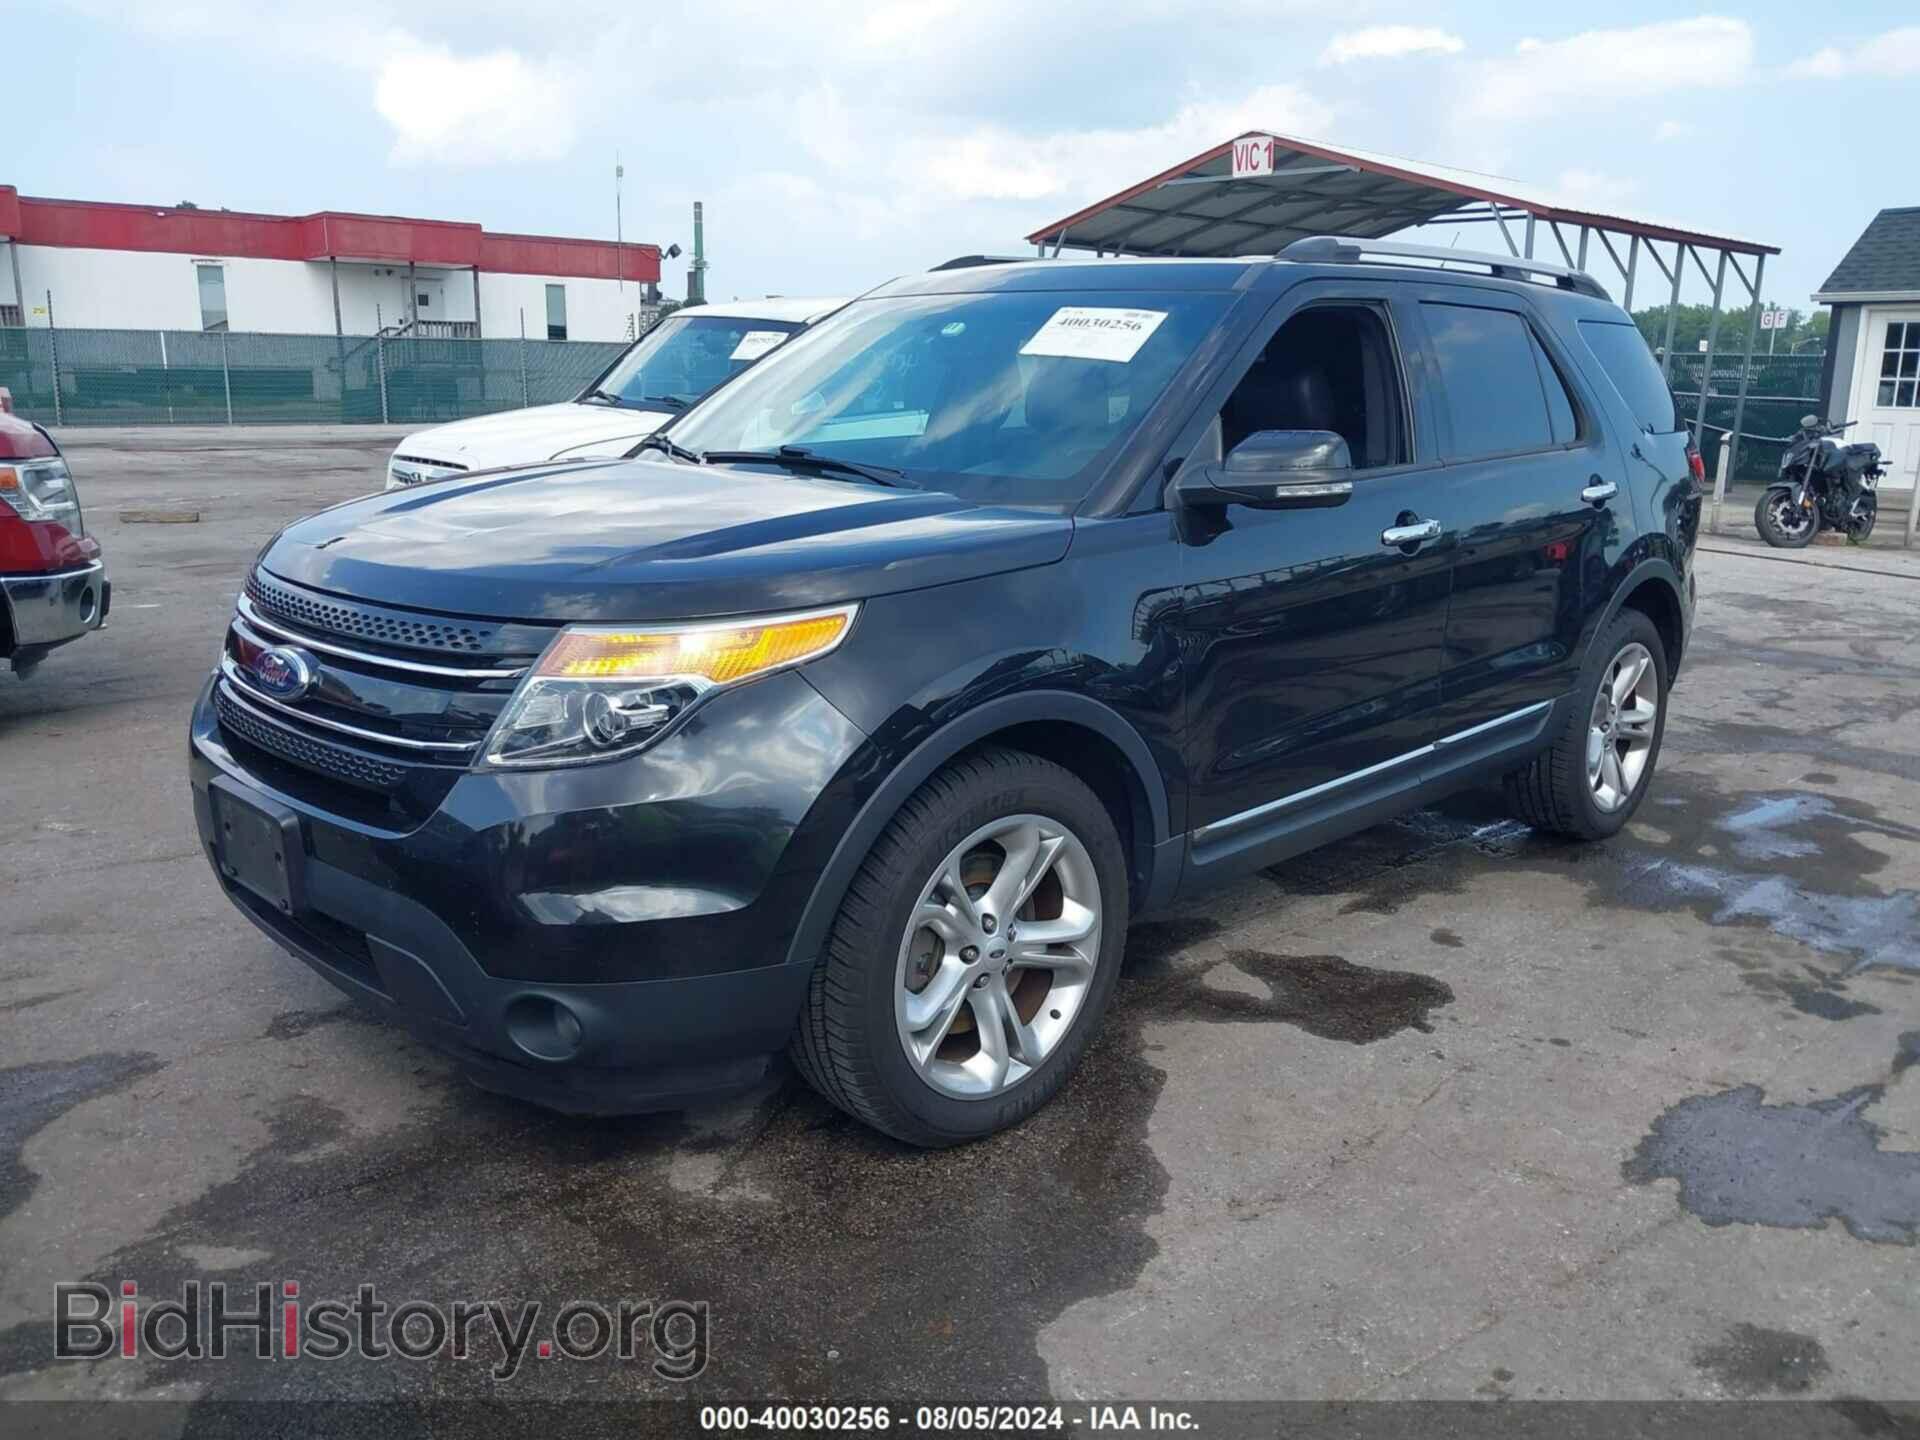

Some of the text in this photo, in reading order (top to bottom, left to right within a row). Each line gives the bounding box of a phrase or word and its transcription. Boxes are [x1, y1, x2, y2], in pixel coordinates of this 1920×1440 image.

[1234, 141, 1273, 172] VIC 1
[1057, 316, 1143, 332] 40030256
[1763, 313, 1771, 326] G
[257, 655, 290, 687] Ford
